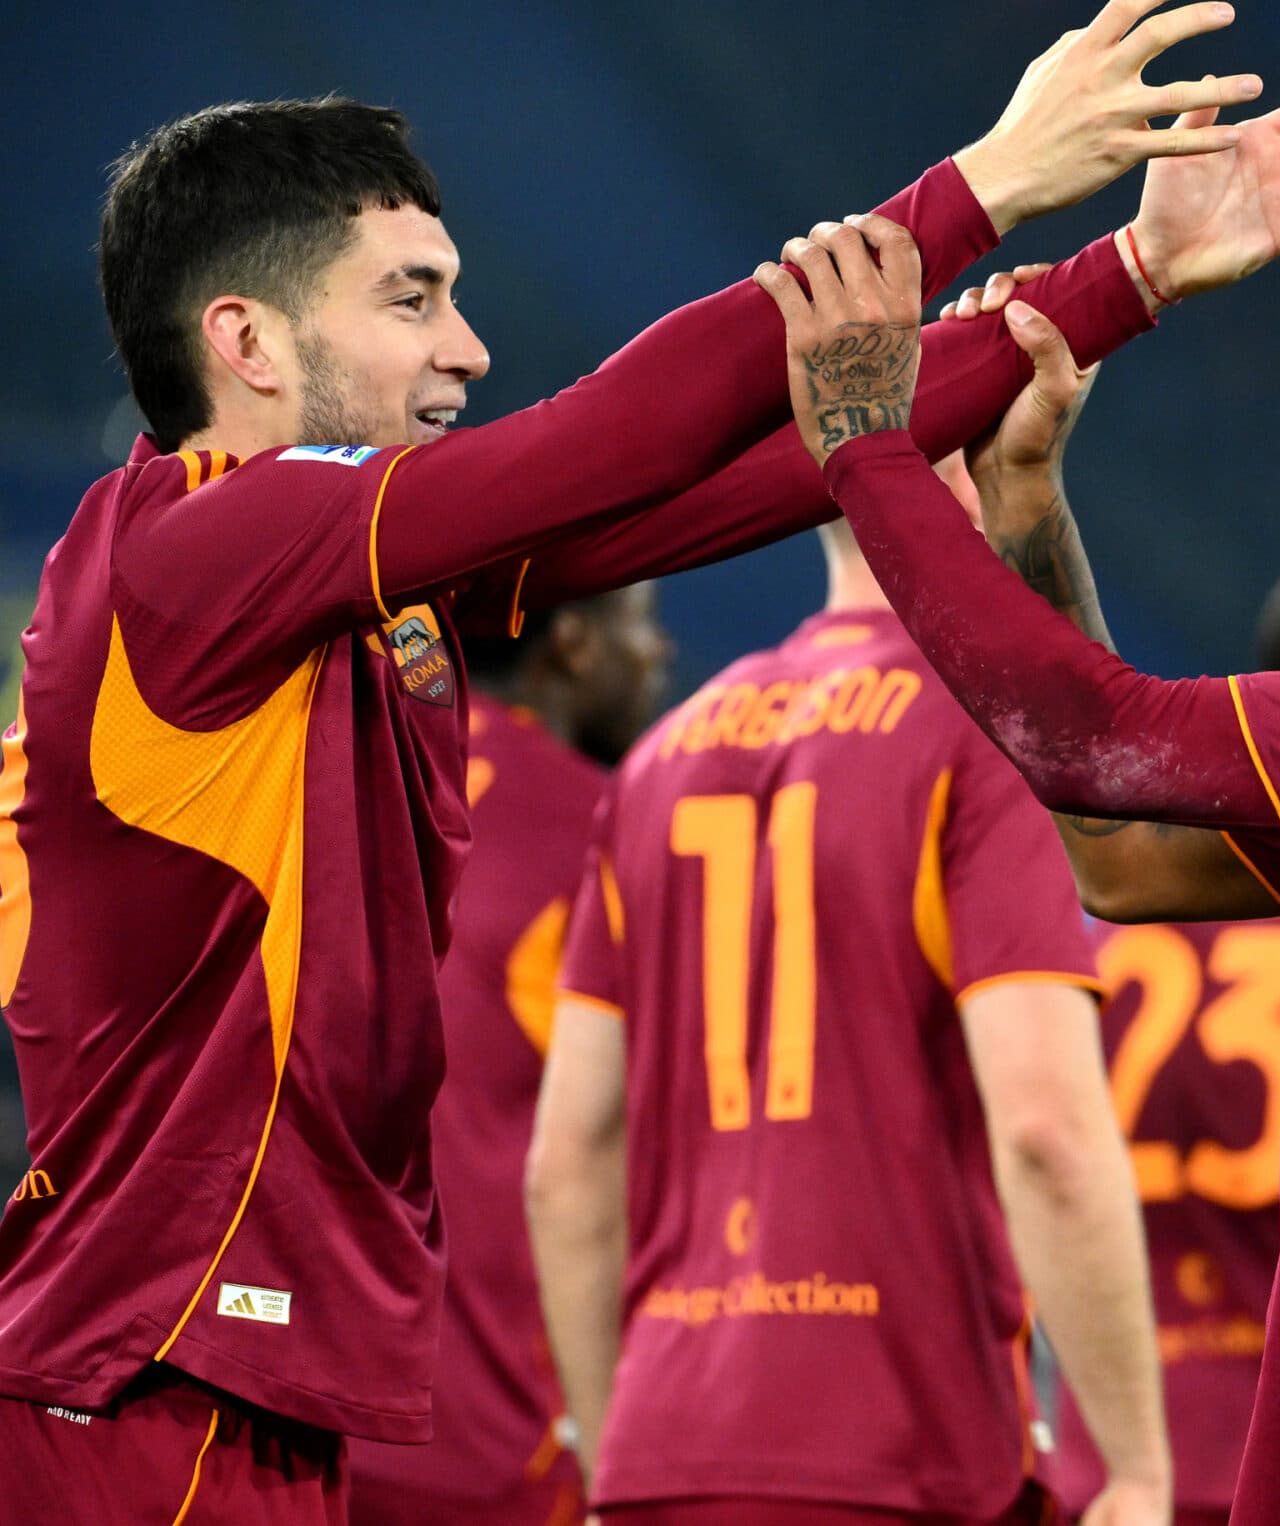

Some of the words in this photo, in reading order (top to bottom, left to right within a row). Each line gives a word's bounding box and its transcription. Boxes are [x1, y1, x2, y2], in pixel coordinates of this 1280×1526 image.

[402, 653, 449, 692] ROMA
[427, 680, 446, 698] 1927
[670, 780, 817, 1131] 11
